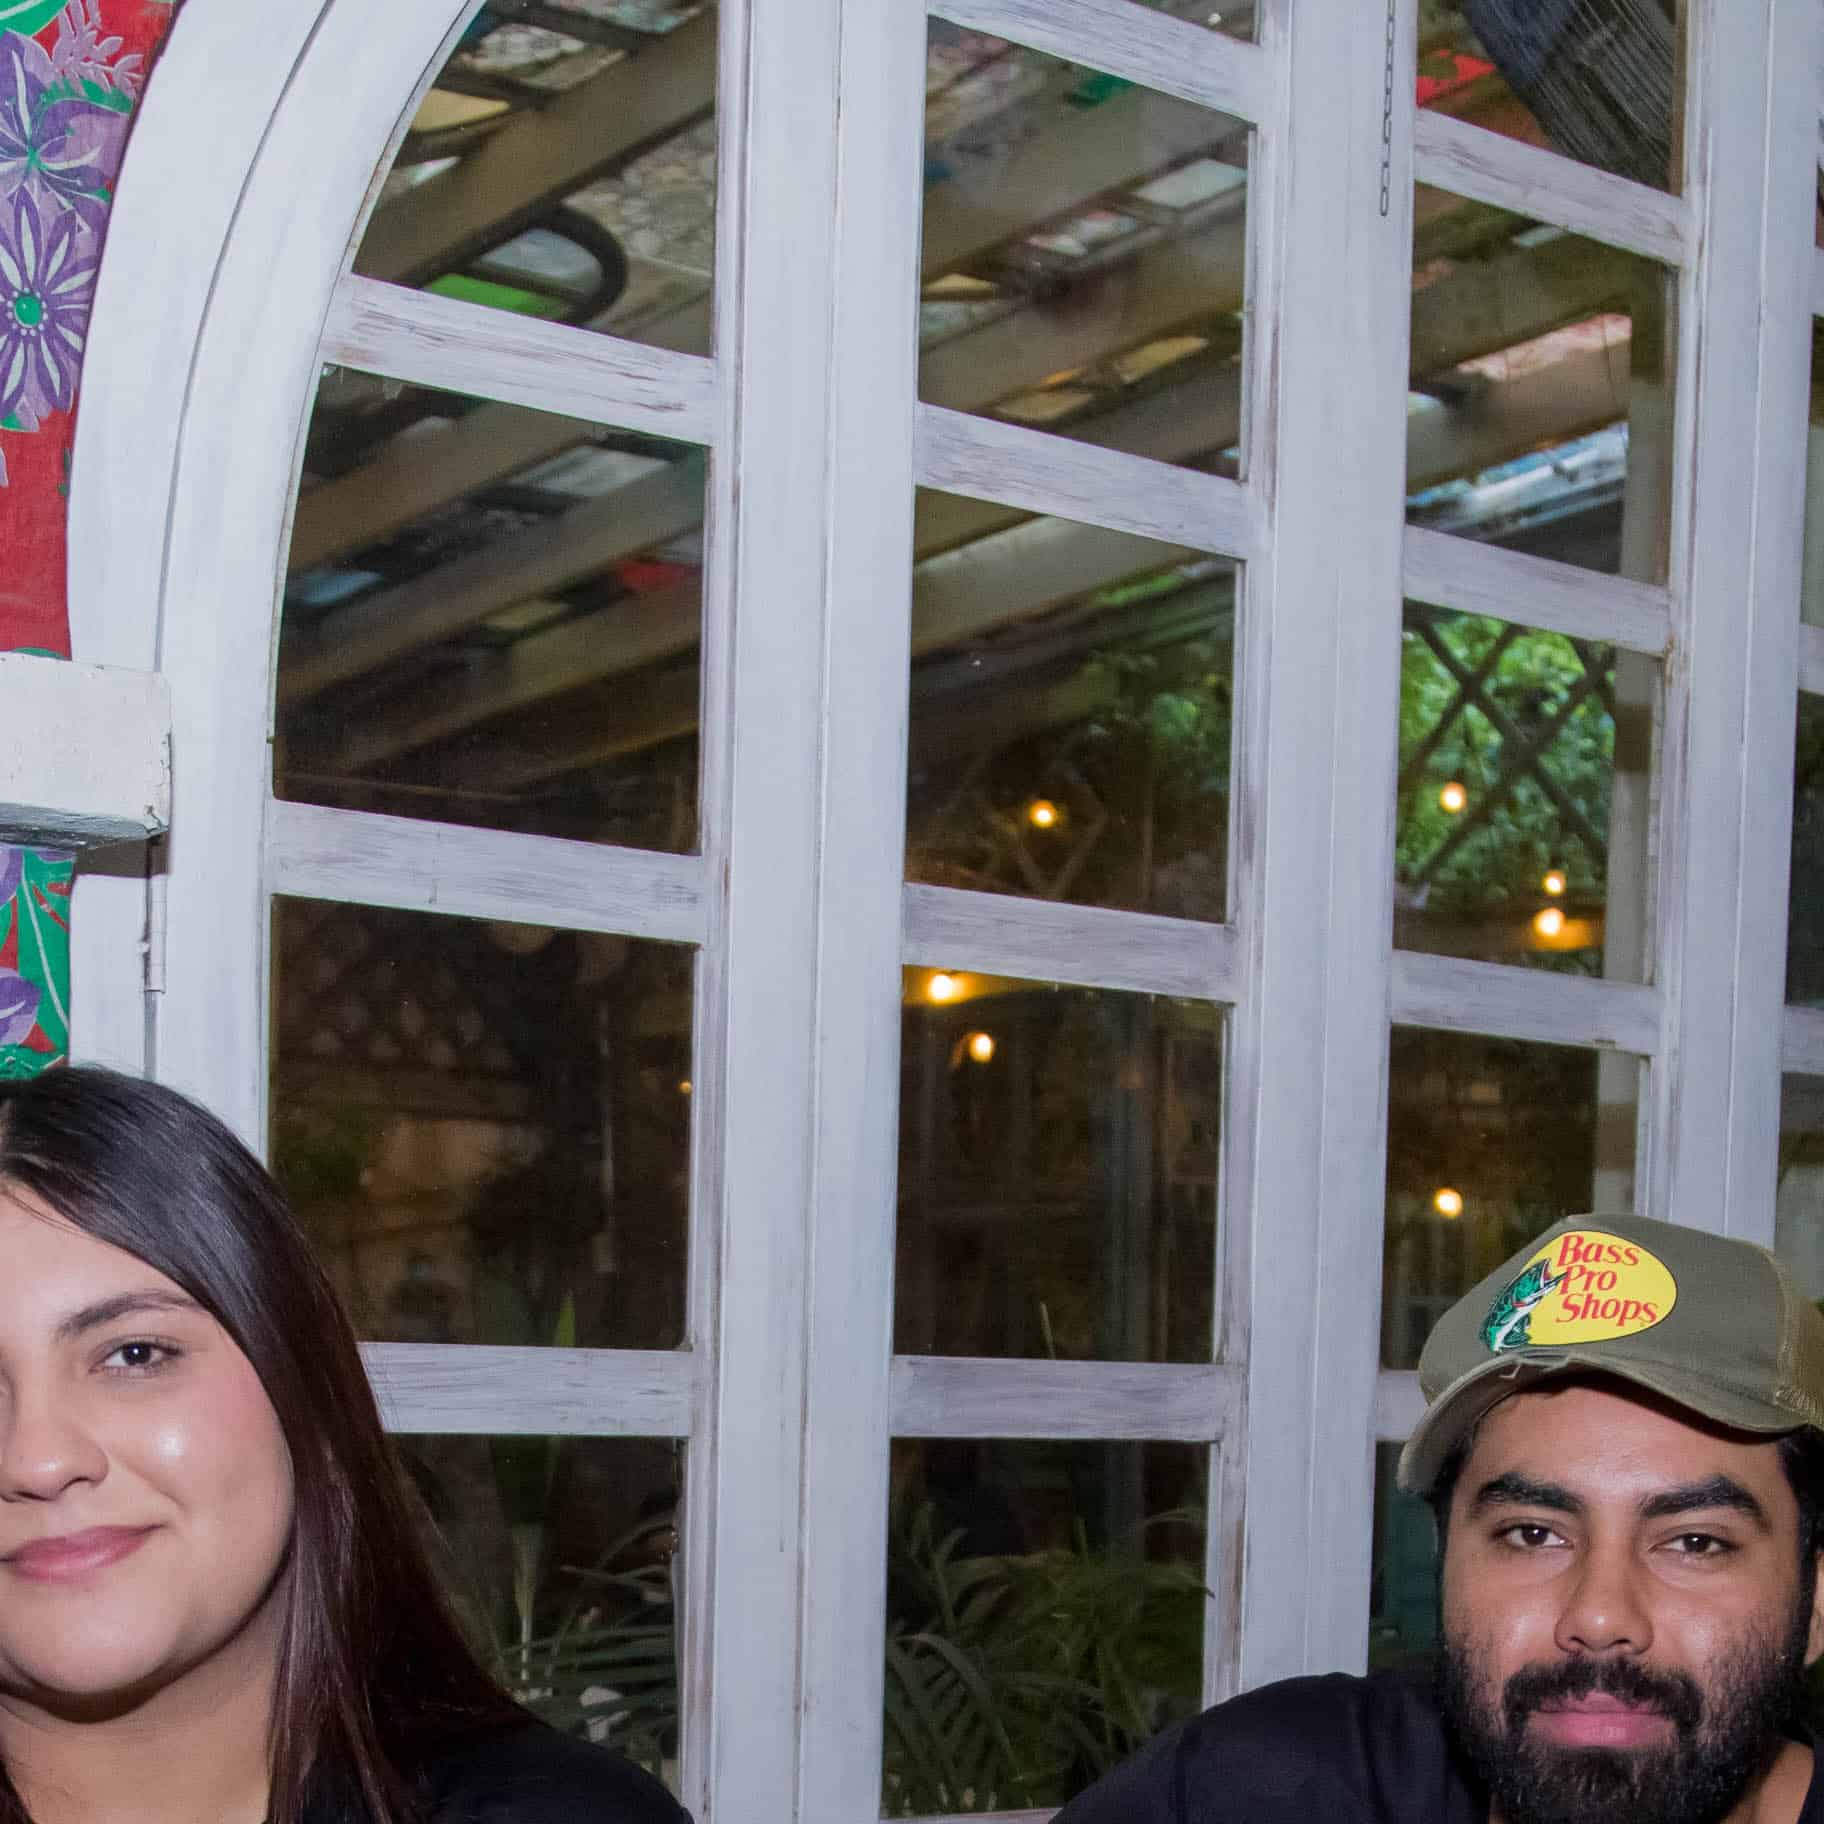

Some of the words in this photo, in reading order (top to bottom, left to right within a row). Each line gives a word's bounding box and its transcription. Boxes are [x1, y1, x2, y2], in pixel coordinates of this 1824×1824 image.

[1556, 1234, 1641, 1267] Bass
[1559, 1264, 1617, 1295] Pro
[1556, 1293, 1659, 1328] Shops
